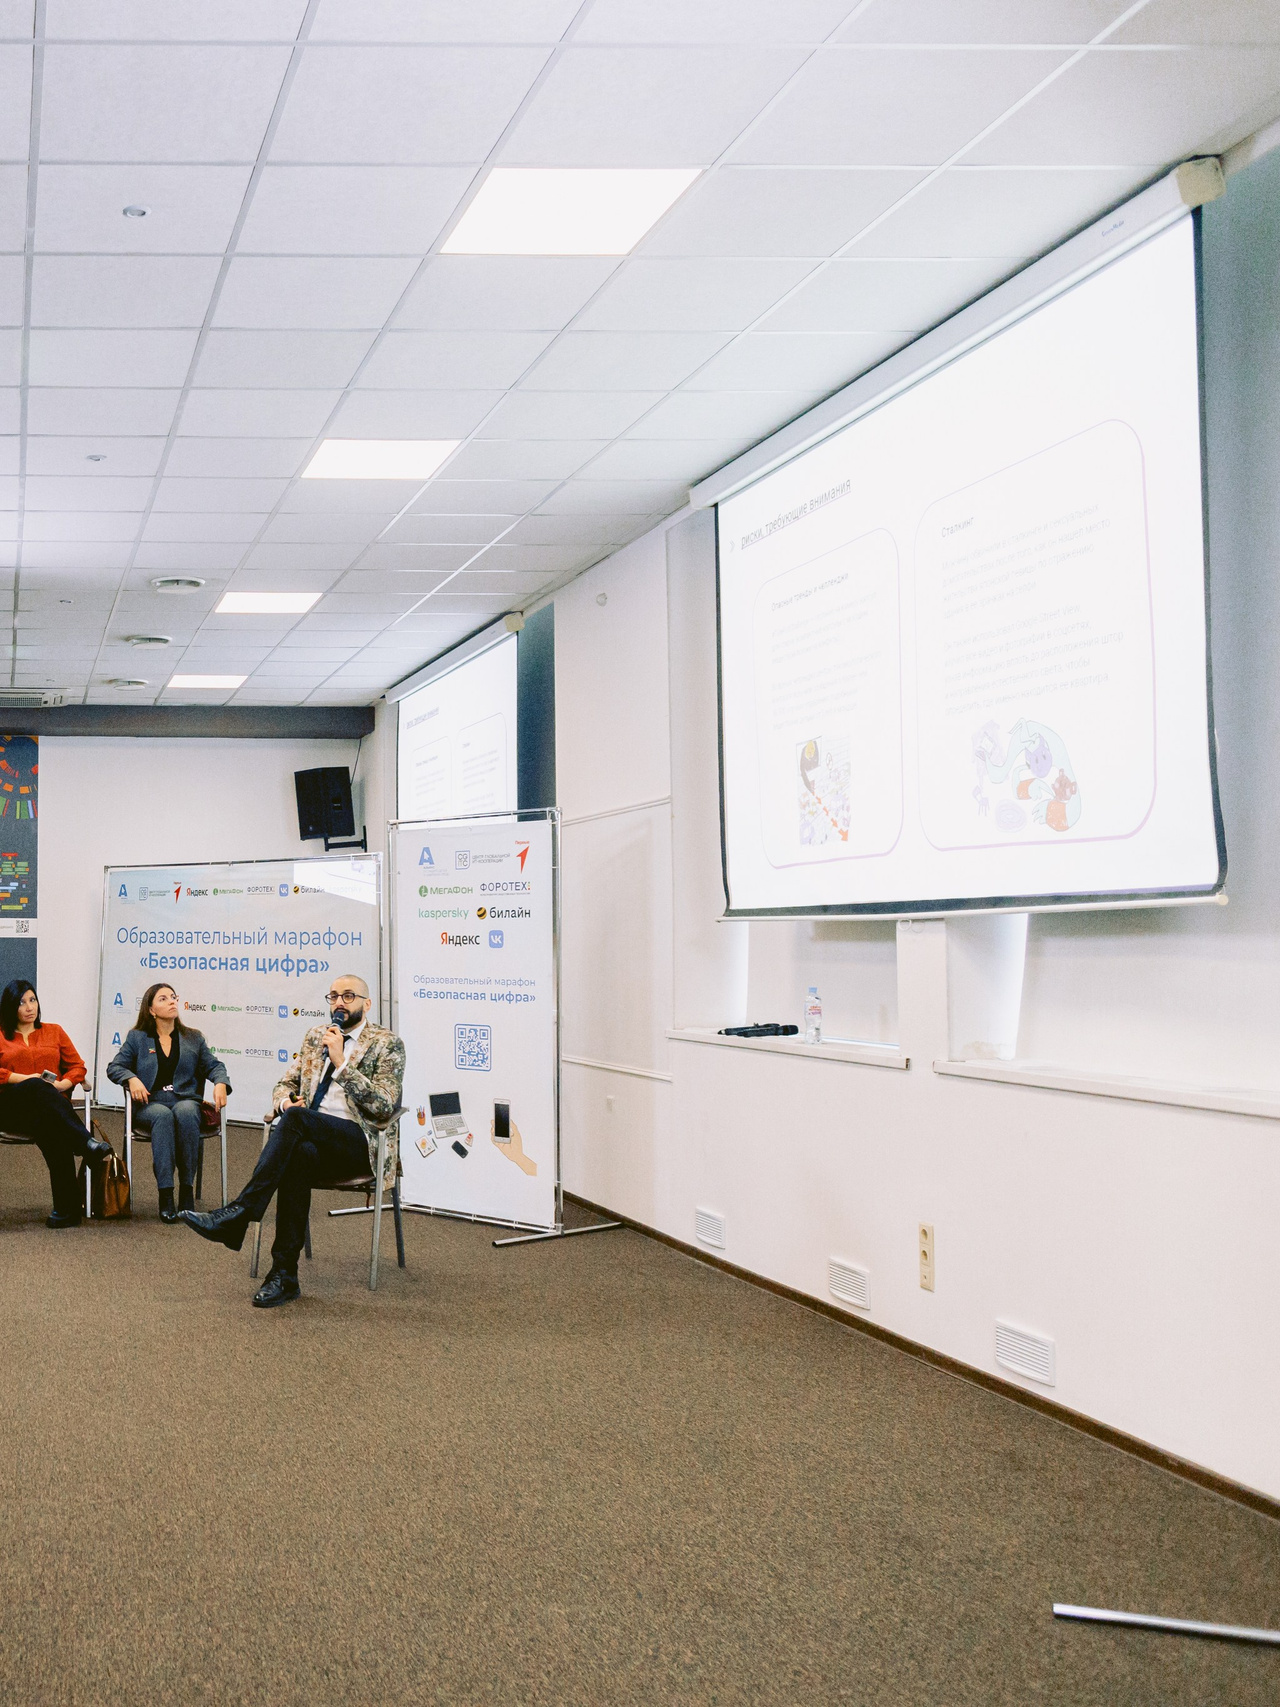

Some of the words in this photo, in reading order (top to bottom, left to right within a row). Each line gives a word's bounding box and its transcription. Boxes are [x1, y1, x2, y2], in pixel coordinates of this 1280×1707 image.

[810, 478, 851, 510] внимания
[941, 517, 974, 538] Сталкинг
[1085, 518, 1110, 534] место
[1048, 543, 1094, 566] отражению
[1101, 631, 1124, 645] штор
[1065, 656, 1090, 670] чтобы
[187, 888, 208, 897] Яндекс
[419, 908, 469, 920] kaspersky
[489, 907, 530, 918] билайн
[117, 926, 268, 948] Образовательный
[274, 926, 362, 950] марафон
[440, 932, 480, 946] Яндекс
[139, 952, 249, 972] «Безопасная
[255, 953, 330, 977] цифра»
[414, 975, 492, 986] Образовательный
[494, 977, 535, 987] марафон
[413, 988, 486, 1001] «Безопасная
[490, 990, 536, 1004] цифра»
[184, 1001, 207, 1012] Яндекс
[301, 1008, 325, 1017] билайн
